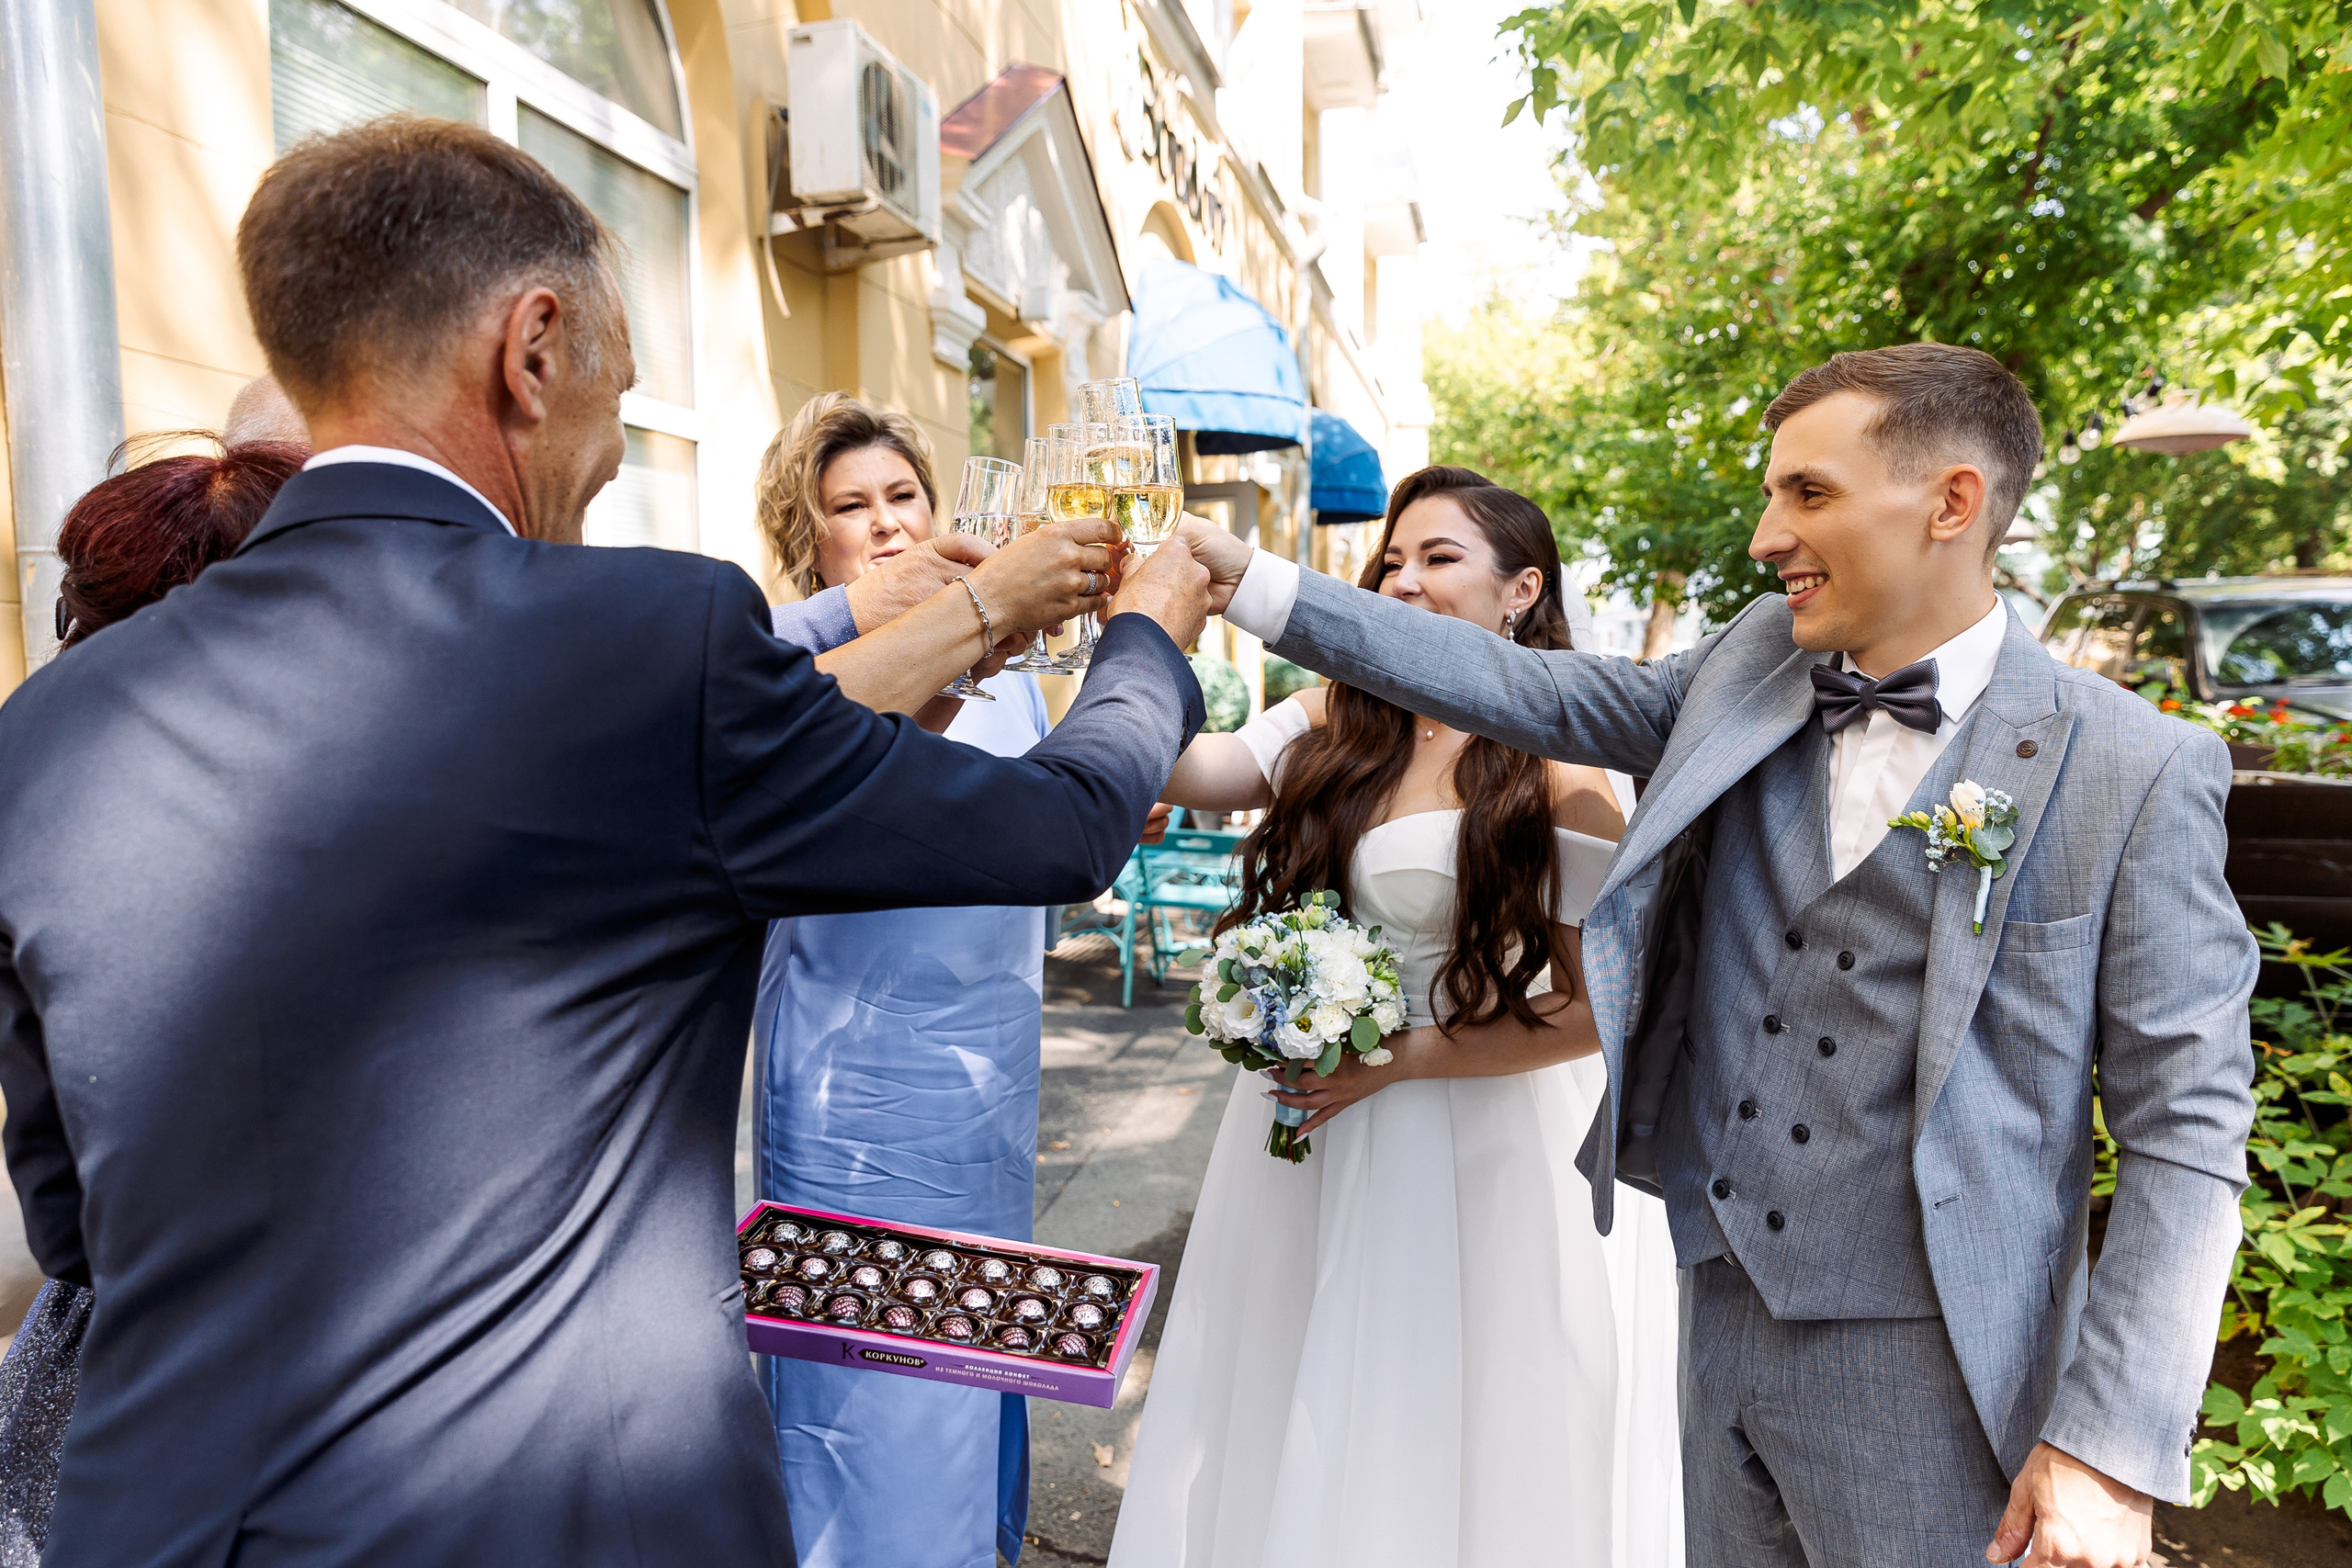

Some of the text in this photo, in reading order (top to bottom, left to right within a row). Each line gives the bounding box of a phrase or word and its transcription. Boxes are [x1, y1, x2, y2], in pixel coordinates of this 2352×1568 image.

[945, 1368, 975, 1377] ТЕМНОГО
[981, 1374, 1022, 1384] МОЛОЧНОГО
[1023, 1380, 1059, 1391] ШОКОЛАДА
